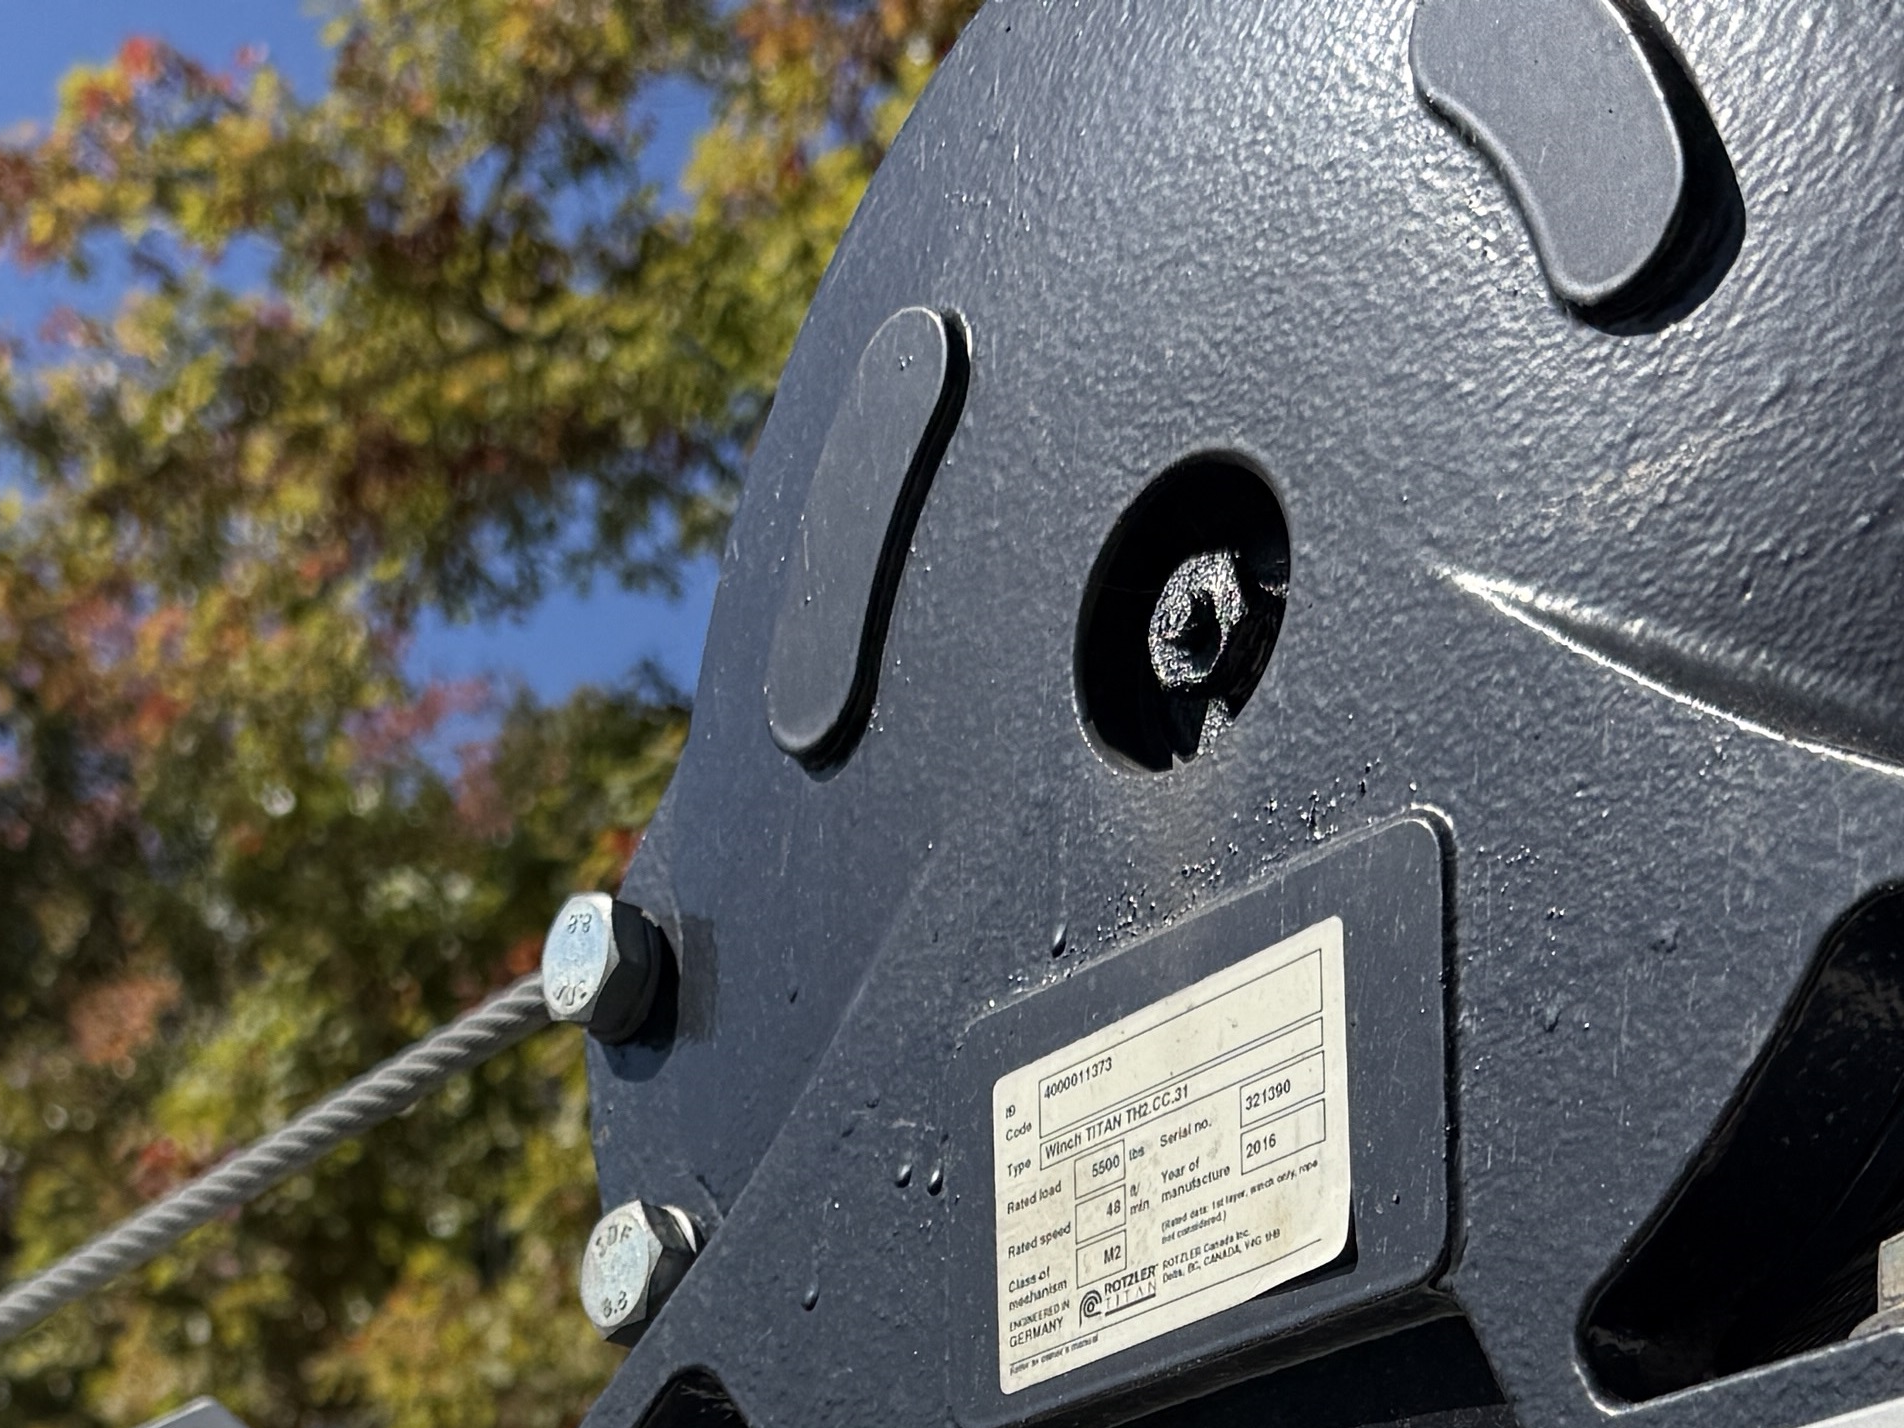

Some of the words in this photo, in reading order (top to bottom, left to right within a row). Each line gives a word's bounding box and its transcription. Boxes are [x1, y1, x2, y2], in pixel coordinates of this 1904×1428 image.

[1044, 1056, 1113, 1099] 4000011373
[1245, 1079, 1291, 1111] 321390
[1005, 1121, 1032, 1142] Code
[1045, 1132, 1081, 1159] Winch
[1085, 1113, 1122, 1142] TITAN
[1160, 1122, 1192, 1148] Serial
[1194, 1118, 1212, 1133] no.
[1246, 1133, 1277, 1158] 2016
[1007, 1158, 1032, 1178] Type
[1091, 1154, 1120, 1178] 5500
[1161, 1164, 1185, 1184] Year
[1188, 1156, 1200, 1172] of
[1007, 1192, 1037, 1215] Rated
[1039, 1180, 1062, 1203] load
[1161, 1165, 1231, 1203] manufacture
[1106, 1200, 1121, 1217] 48
[1008, 1235, 1038, 1259] Rated
[1039, 1221, 1072, 1246] speed
[1103, 1245, 1122, 1265] M2
[1008, 1274, 1037, 1293] Class
[1038, 1265, 1051, 1280] of
[1104, 1264, 1156, 1295] ROTZLER
[1008, 1279, 1068, 1311] mechanism
[1009, 1317, 1064, 1348] GERMANY
